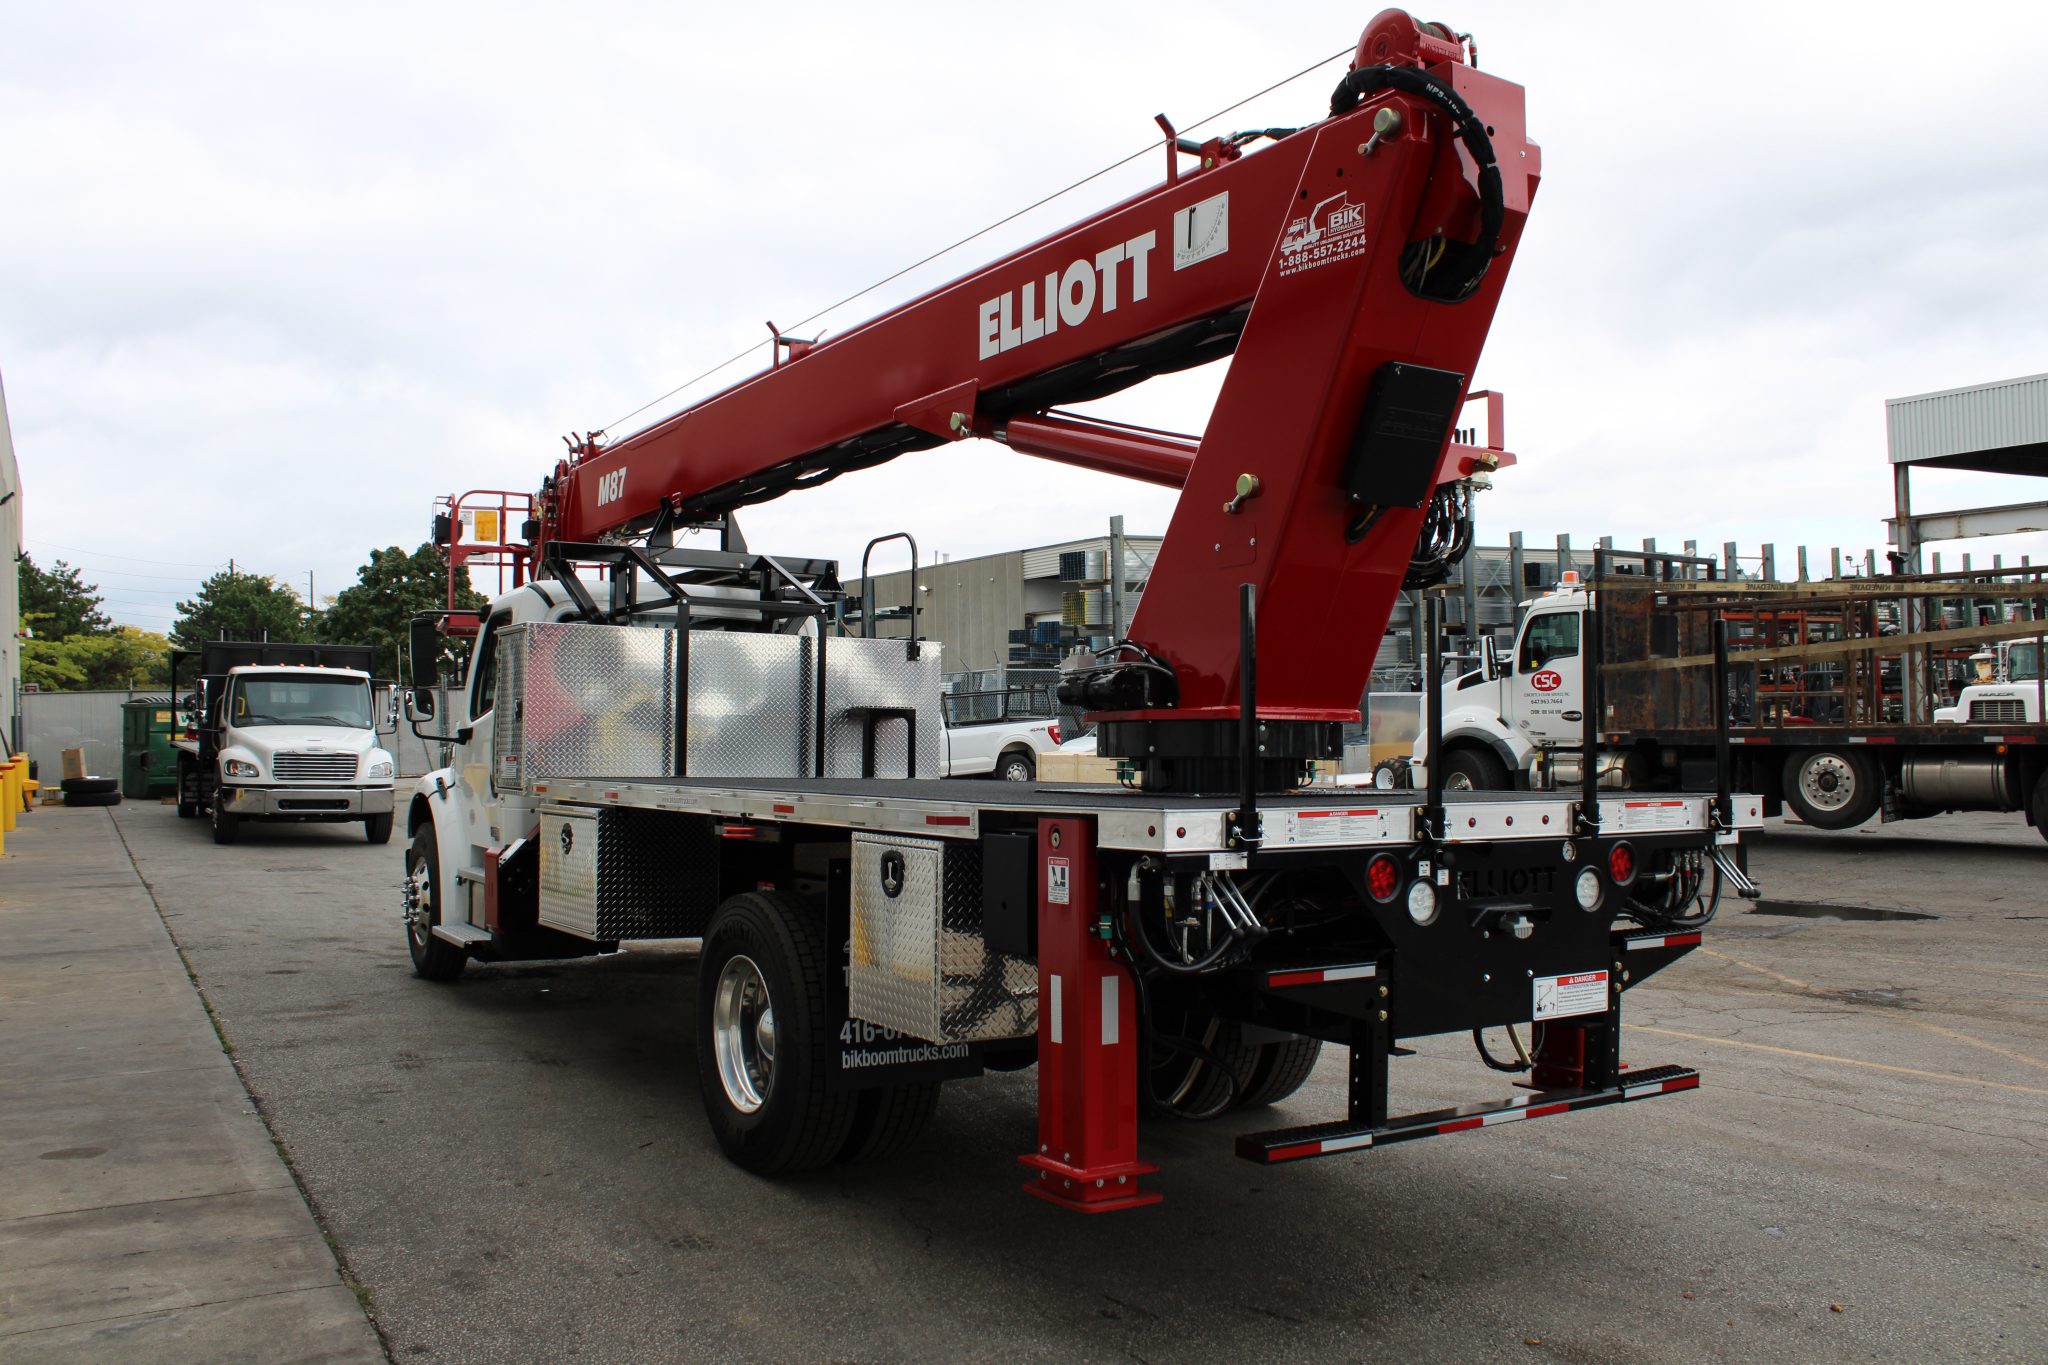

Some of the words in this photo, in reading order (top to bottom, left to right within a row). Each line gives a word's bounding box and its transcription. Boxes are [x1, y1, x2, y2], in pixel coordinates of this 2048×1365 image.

[1330, 207, 1362, 228] BIK
[1279, 234, 1366, 269] 1-888-557-2244
[1280, 248, 1365, 277] www.bikboomtrucks.com
[979, 229, 1156, 361] ELLIOTT
[598, 466, 627, 507] M87
[1745, 583, 1785, 591] KINEDYNE
[1849, 584, 1891, 592] KINEDYNE
[1534, 674, 1557, 688] CSC
[1574, 974, 1597, 983] DANGER
[842, 1043, 969, 1069] bikboomtrucks.com
